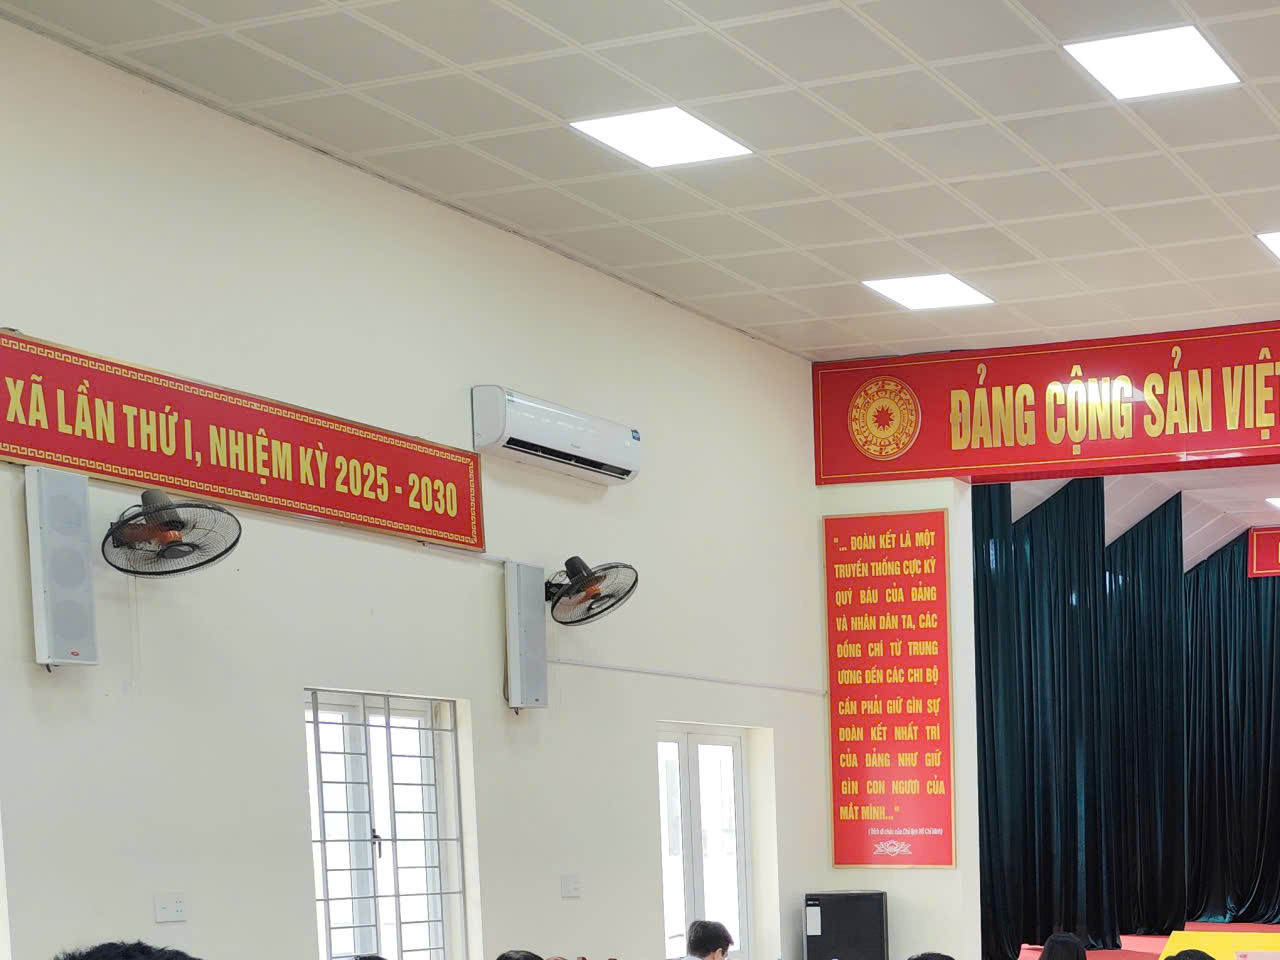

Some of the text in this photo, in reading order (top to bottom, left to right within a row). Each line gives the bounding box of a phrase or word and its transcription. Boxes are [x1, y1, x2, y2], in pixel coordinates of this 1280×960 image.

[950, 363, 1035, 450] ĐẢNG
[1046, 365, 1133, 455] CỘNG
[1143, 346, 1212, 437] SẢN
[5, 374, 457, 517] XÃ LẦN THỨ I, NHIỆM KỲ 2025 - 2030
[851, 529, 935, 551] ĐOÀN KẾT LÀ MỘT
[886, 582, 904, 603] CỦA
[911, 581, 937, 602] ĐẢNG
[836, 614, 847, 631] VÀ
[851, 614, 876, 630] NHÂN
[919, 611, 938, 629] CÁC
[908, 641, 938, 656] TRUNG
[886, 666, 904, 683] CÁC
[908, 667, 922, 683] CHI
[926, 665, 938, 686] BỘ
[862, 695, 882, 715] PHẢI
[927, 698, 940, 717] SỰ
[840, 748, 858, 768] CỦA
[866, 748, 890, 767] ĐẢNG
[898, 752, 918, 767] NHƯ
[867, 780, 885, 794] CON
[927, 775, 945, 794] CỦA
